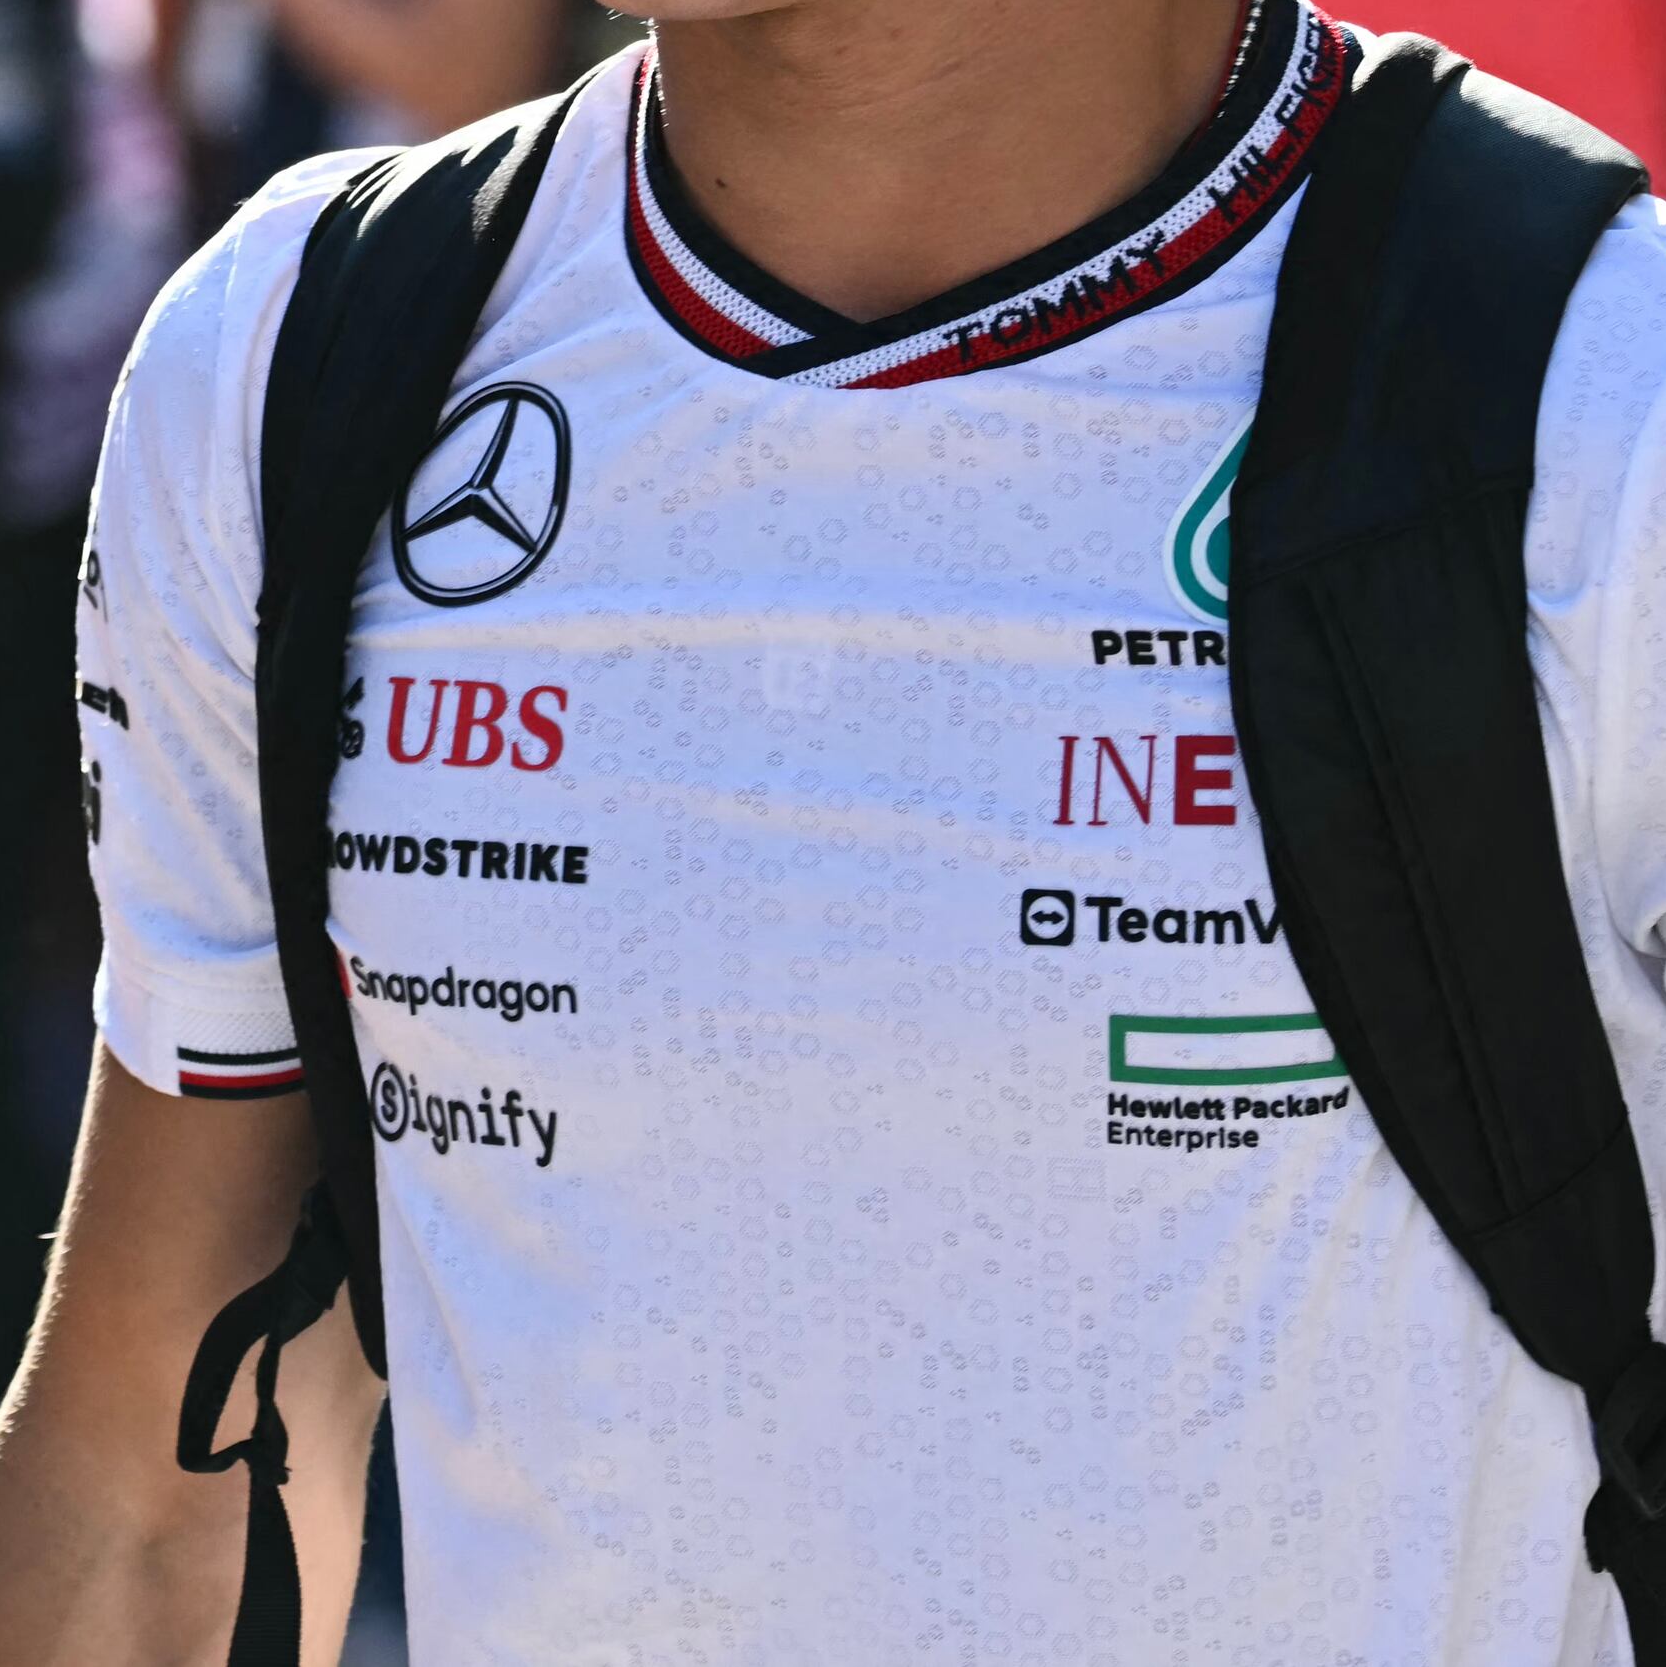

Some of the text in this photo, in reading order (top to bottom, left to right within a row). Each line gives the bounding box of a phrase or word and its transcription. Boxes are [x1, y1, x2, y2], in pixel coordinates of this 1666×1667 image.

[943, 230, 1165, 364] TOMMY
[387, 676, 569, 773] UBS
[1053, 735, 1237, 826] INE
[329, 830, 589, 884] OWDSTRIKE
[350, 955, 578, 1022] Snapdragon
[1107, 1086, 1351, 1121] Hewlett Packard
[1107, 1121, 1260, 1153] Enterprise
